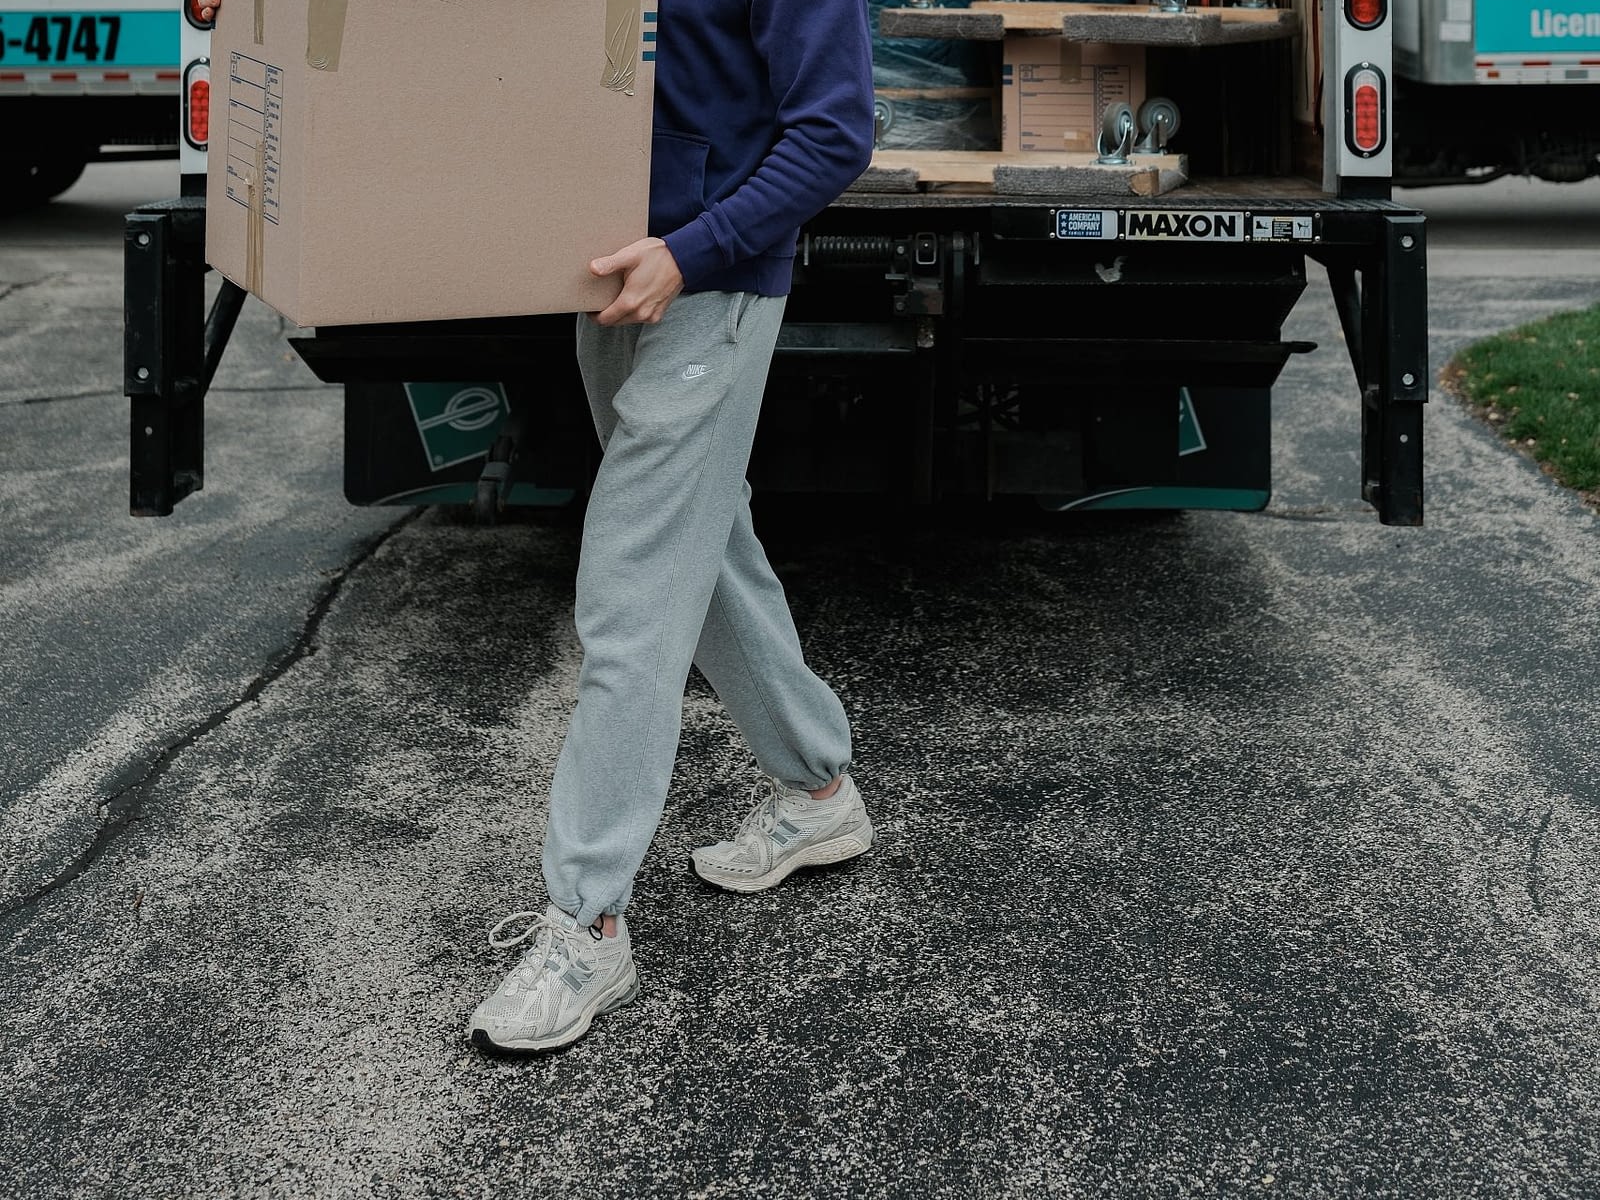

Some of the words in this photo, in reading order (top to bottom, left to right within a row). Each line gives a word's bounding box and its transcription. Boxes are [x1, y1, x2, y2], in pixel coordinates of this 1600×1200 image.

[1531, 10, 1600, 38] Licen
[0, 16, 121, 61] -4747
[1068, 213, 1101, 221] AMERICAN
[1068, 221, 1100, 231] COMPANY
[1128, 214, 1236, 238] MAXON
[686, 364, 707, 375] NIKE
